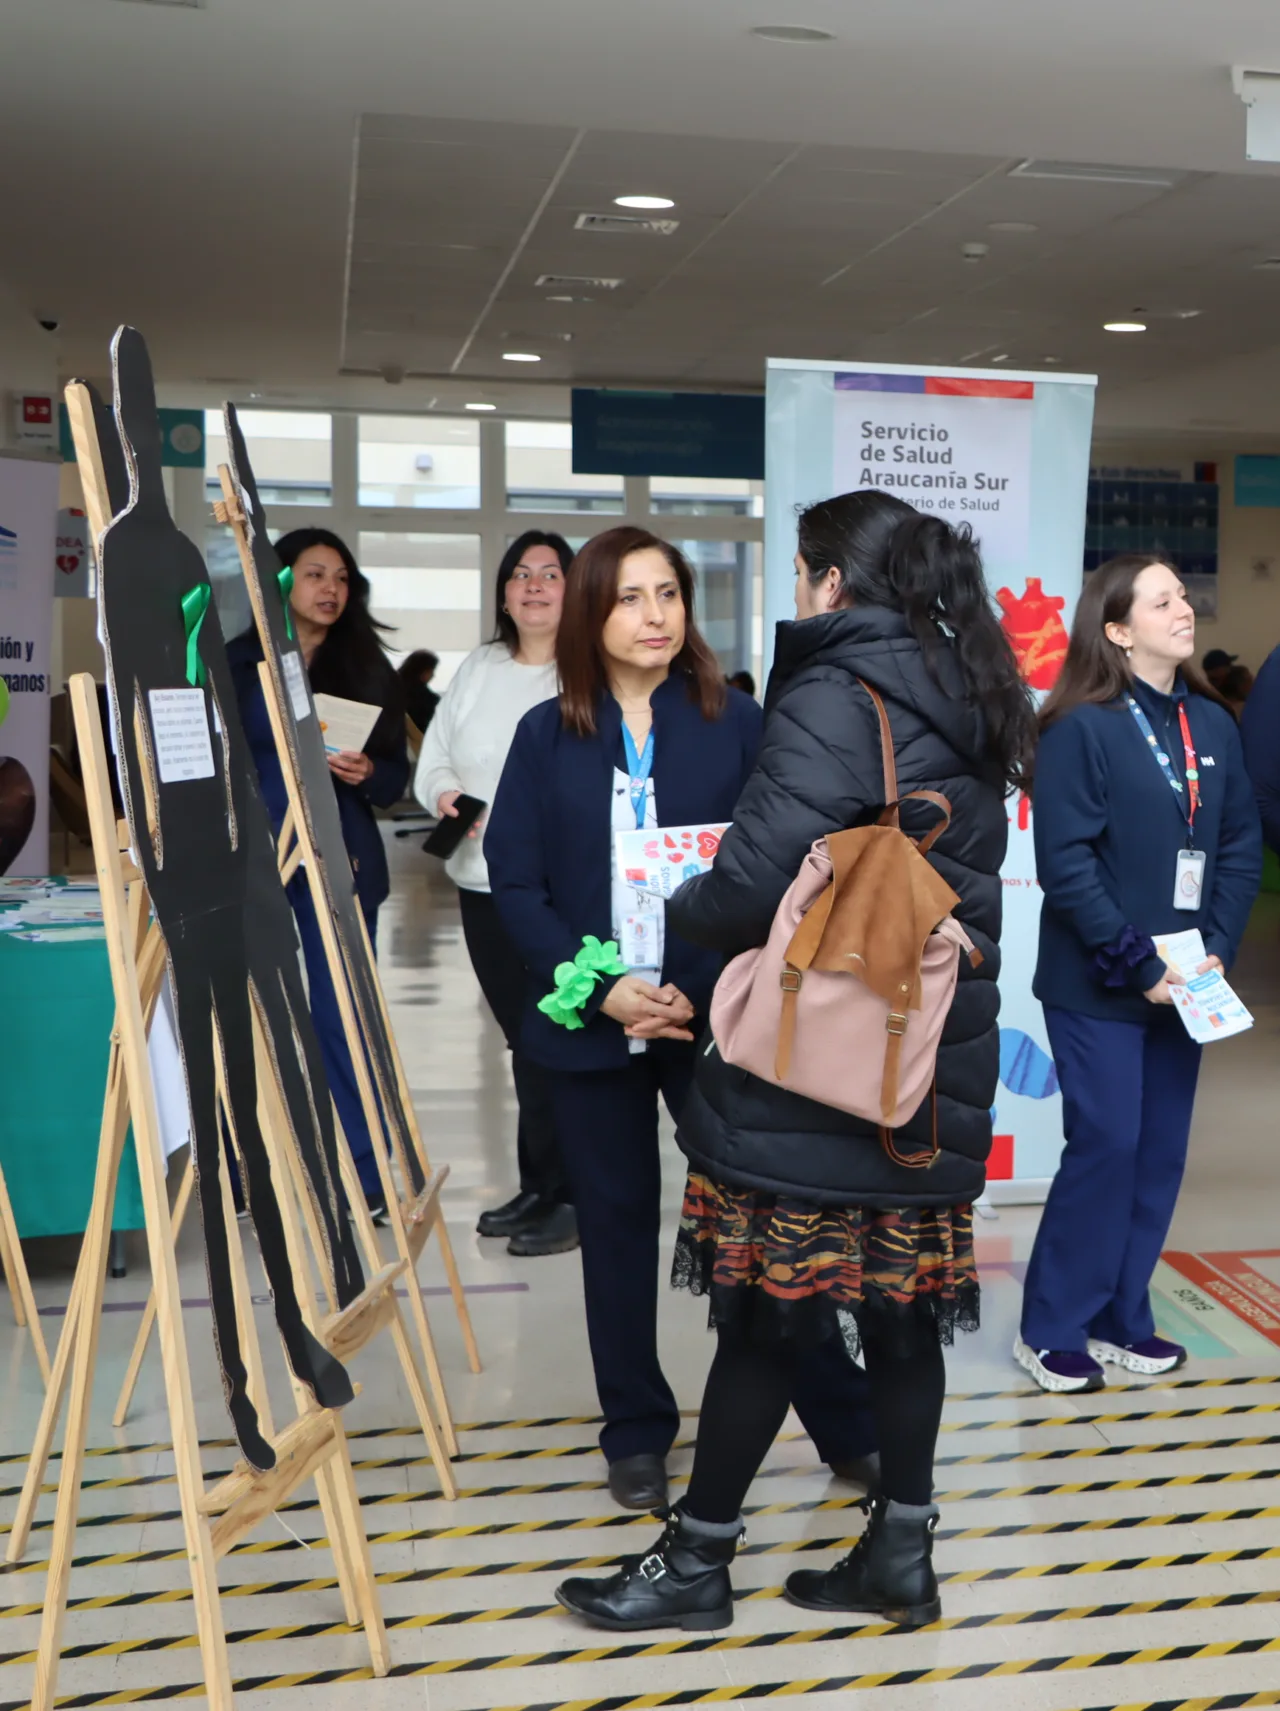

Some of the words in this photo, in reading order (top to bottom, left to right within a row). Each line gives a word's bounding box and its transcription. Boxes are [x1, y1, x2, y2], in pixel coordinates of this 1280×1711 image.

[860, 420, 949, 442] Servicio
[860, 443, 886, 462] de
[892, 445, 953, 465] Salud
[859, 467, 968, 489] Araucanía
[974, 472, 1009, 491] Sur
[938, 497, 956, 509] de
[959, 497, 1000, 511] Salud
[25, 641, 34, 662] y
